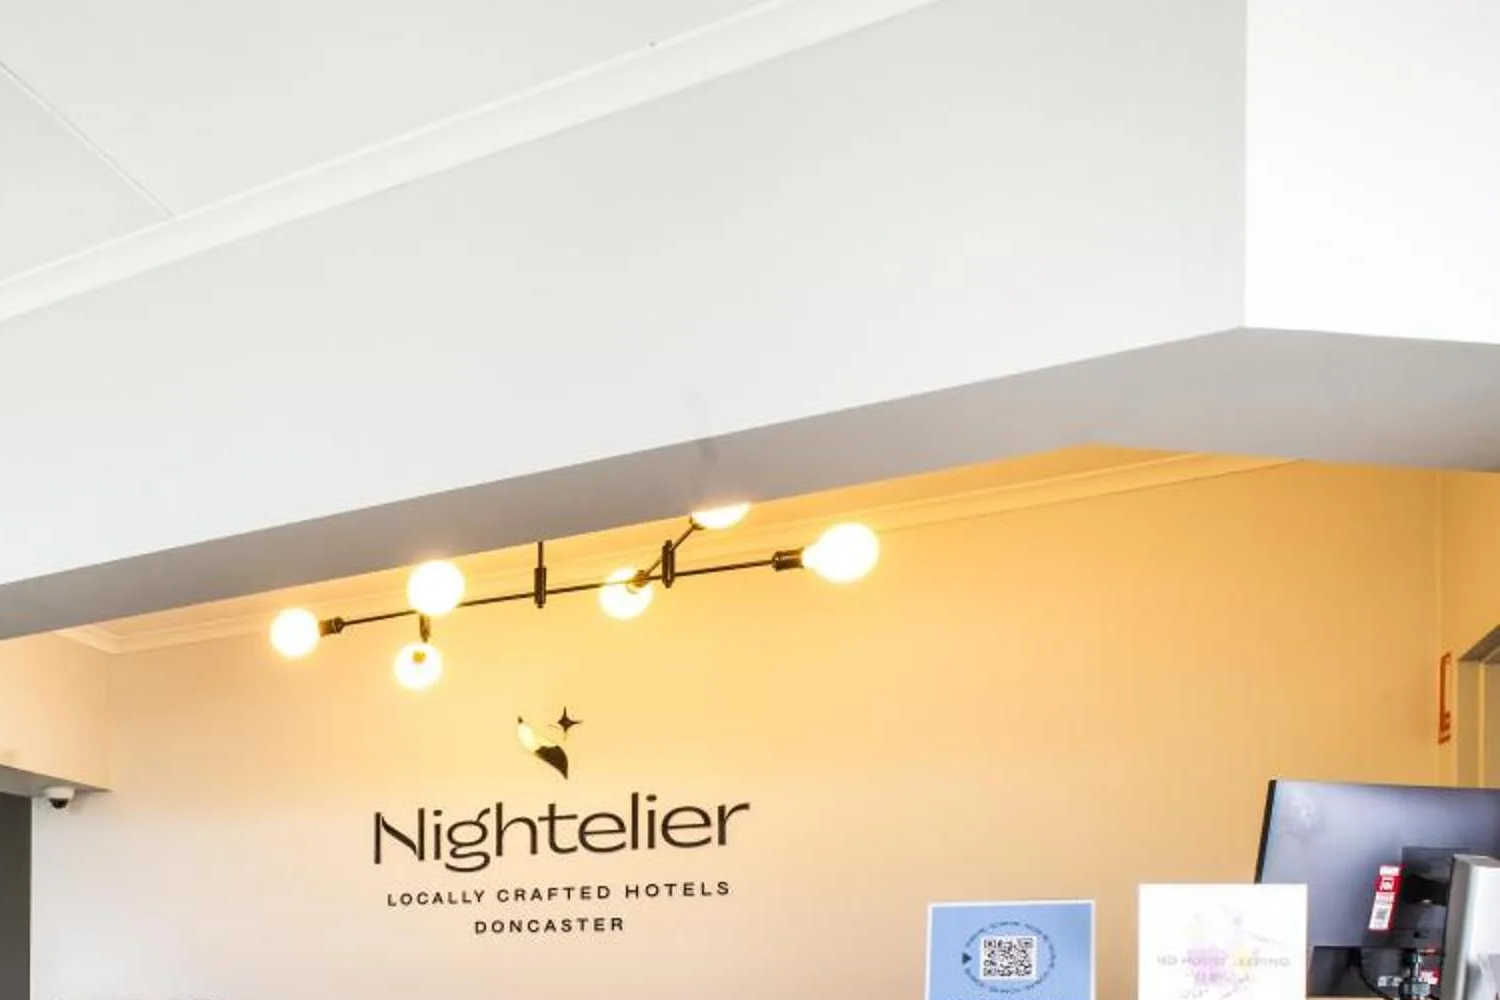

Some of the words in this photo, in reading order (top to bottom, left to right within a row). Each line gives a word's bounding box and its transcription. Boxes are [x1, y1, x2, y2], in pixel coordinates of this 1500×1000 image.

[373, 791, 751, 873] Nightelier
[387, 888, 486, 907] LOCALLY
[496, 884, 611, 903] CRAFTED
[625, 880, 730, 899] HOTELS
[474, 916, 624, 935] DONCASTER
